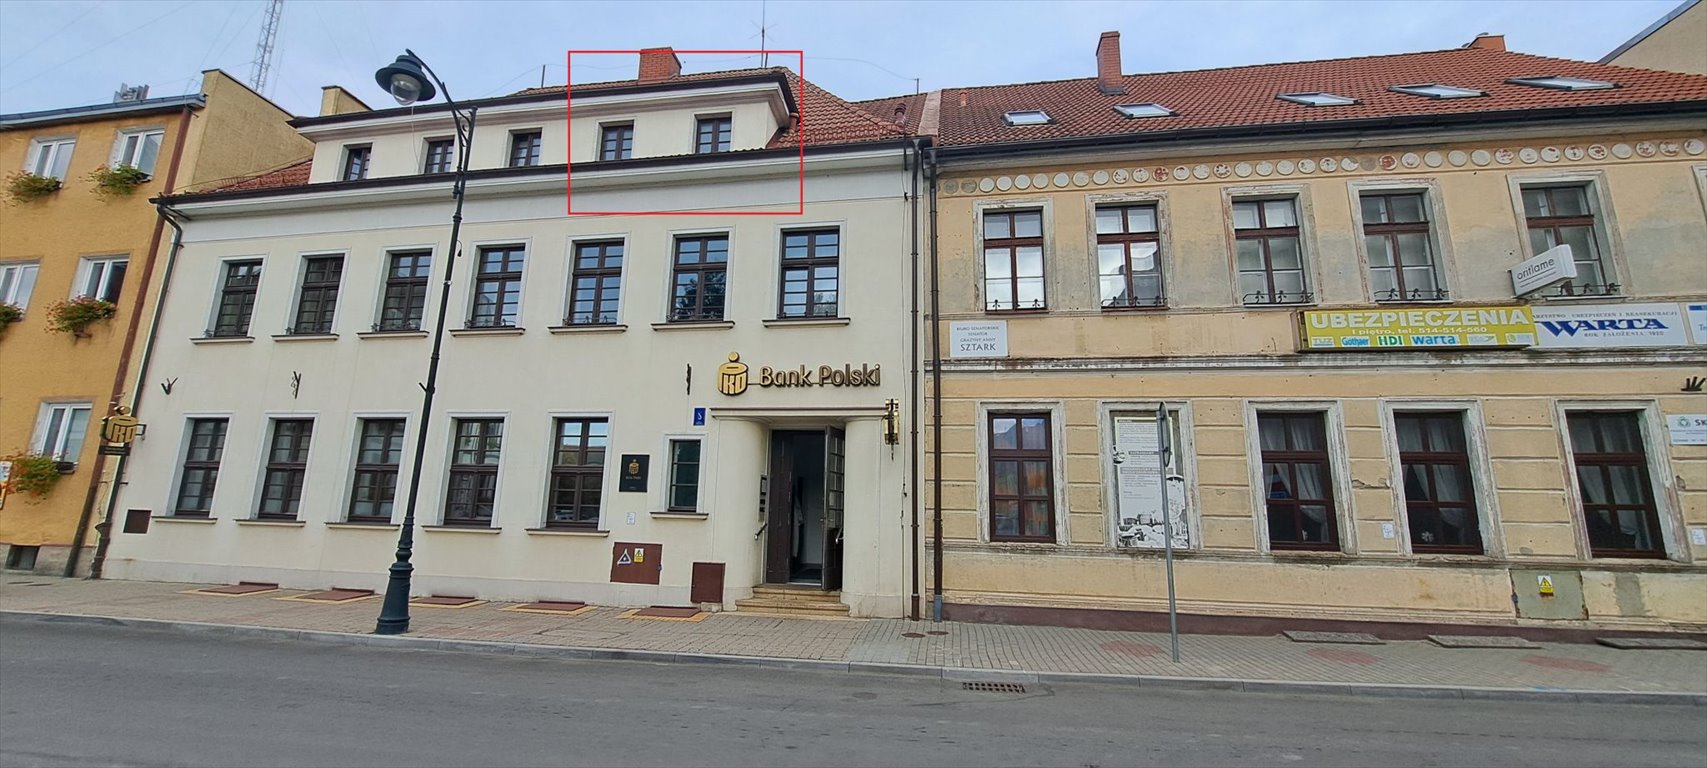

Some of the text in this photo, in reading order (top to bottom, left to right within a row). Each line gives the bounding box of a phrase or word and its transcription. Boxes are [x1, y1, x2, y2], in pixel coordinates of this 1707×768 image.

[1517, 258, 1555, 280] oriflame
[1311, 309, 1530, 329] UBEZPIECZENIA
[1535, 318, 1669, 337] WARTA
[960, 343, 996, 351] SZTARK
[1378, 335, 1403, 345] HDI
[1412, 335, 1456, 345] warta
[760, 364, 812, 387] Bank
[818, 363, 881, 387] Polski
